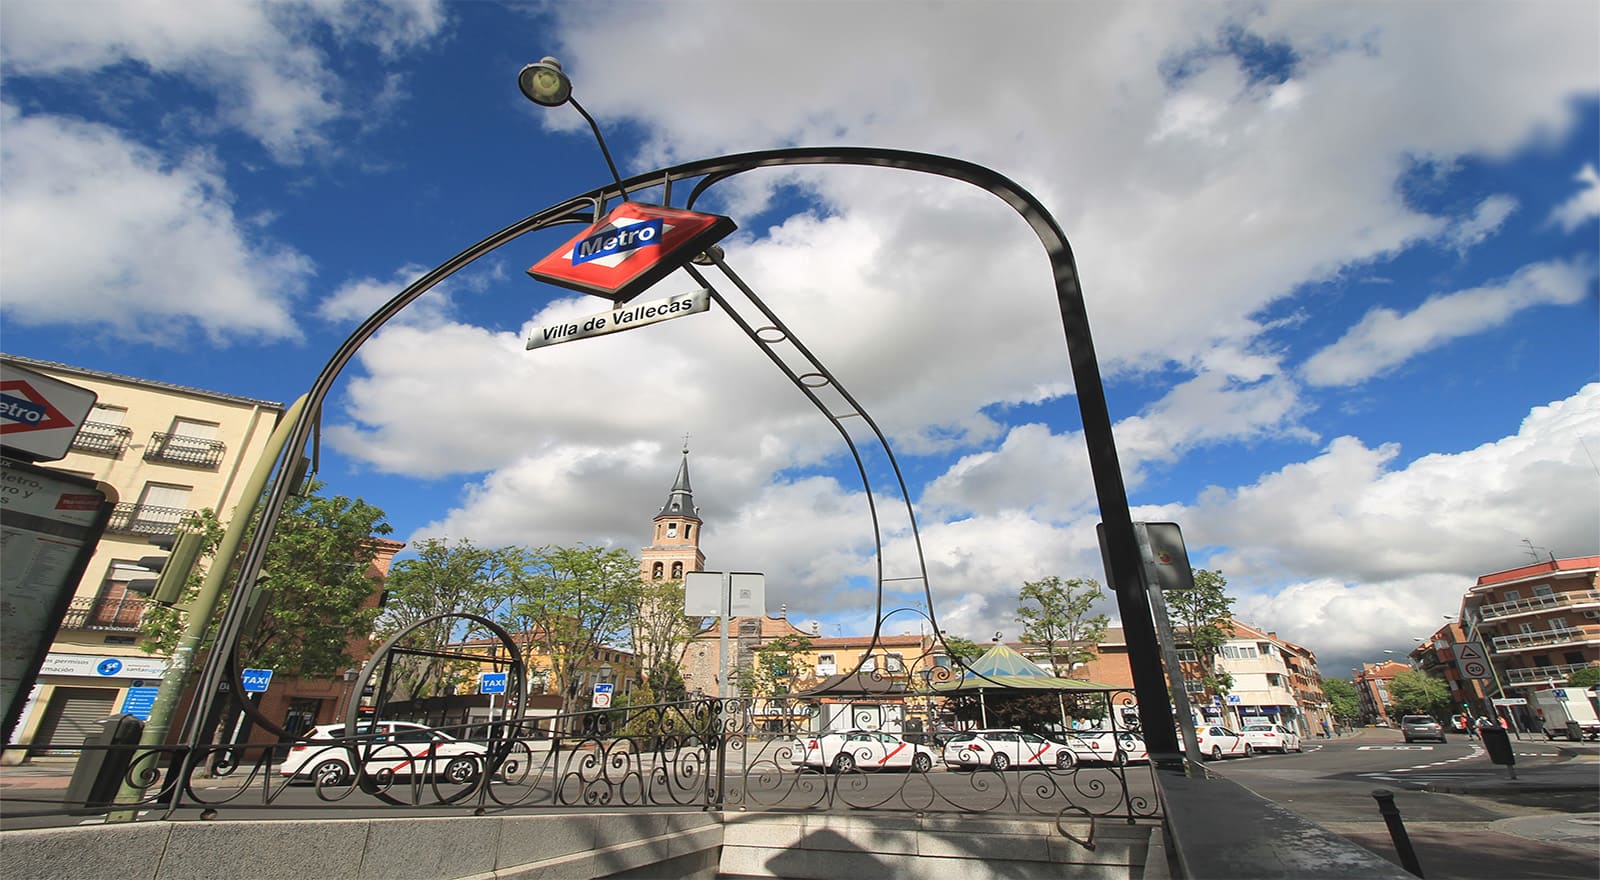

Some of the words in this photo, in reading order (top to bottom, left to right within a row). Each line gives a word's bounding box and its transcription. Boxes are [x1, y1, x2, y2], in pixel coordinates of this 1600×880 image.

[580, 227, 655, 258] Metro
[543, 323, 578, 341] Villa
[583, 317, 606, 332] de
[613, 299, 692, 325] Vallecas
[22, 490, 33, 499] y
[243, 676, 268, 684] TAXI
